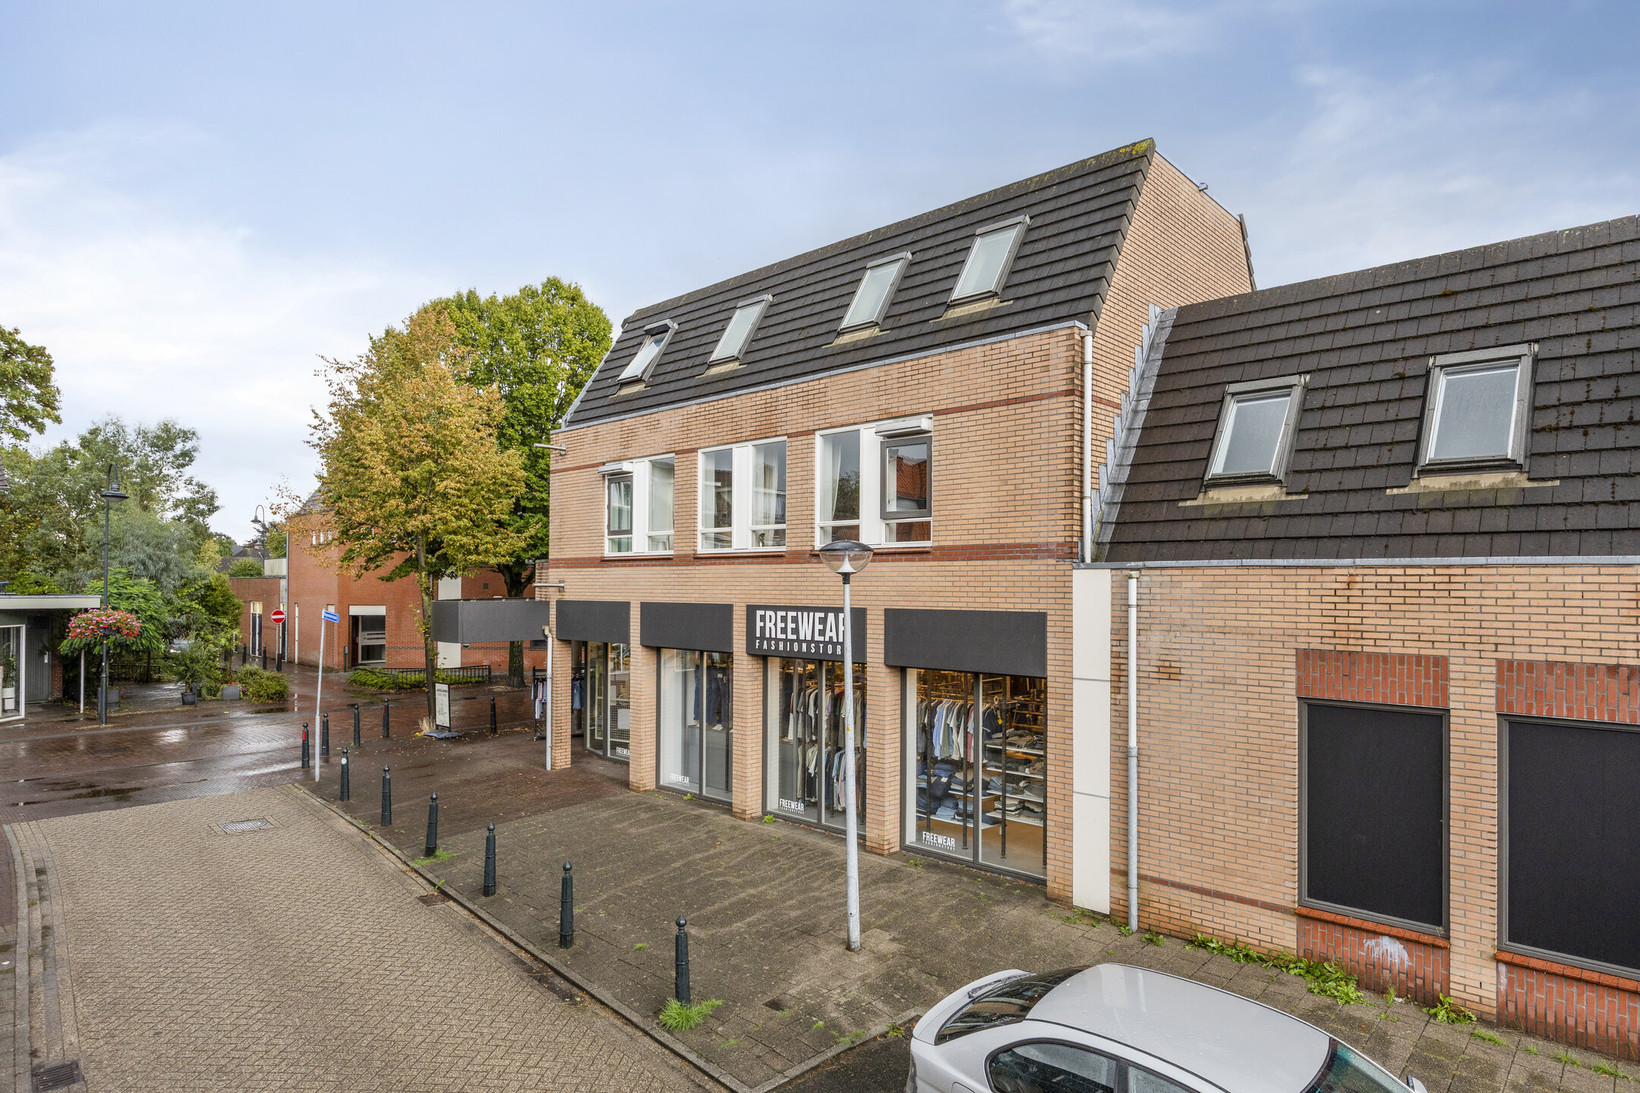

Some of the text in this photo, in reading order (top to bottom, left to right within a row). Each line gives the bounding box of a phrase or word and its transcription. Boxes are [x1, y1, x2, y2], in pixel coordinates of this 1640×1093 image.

[755, 639, 844, 655] FASHIONSTOR
[780, 798, 805, 811] FREEWEAR
[922, 831, 956, 848] FREEWEAR
